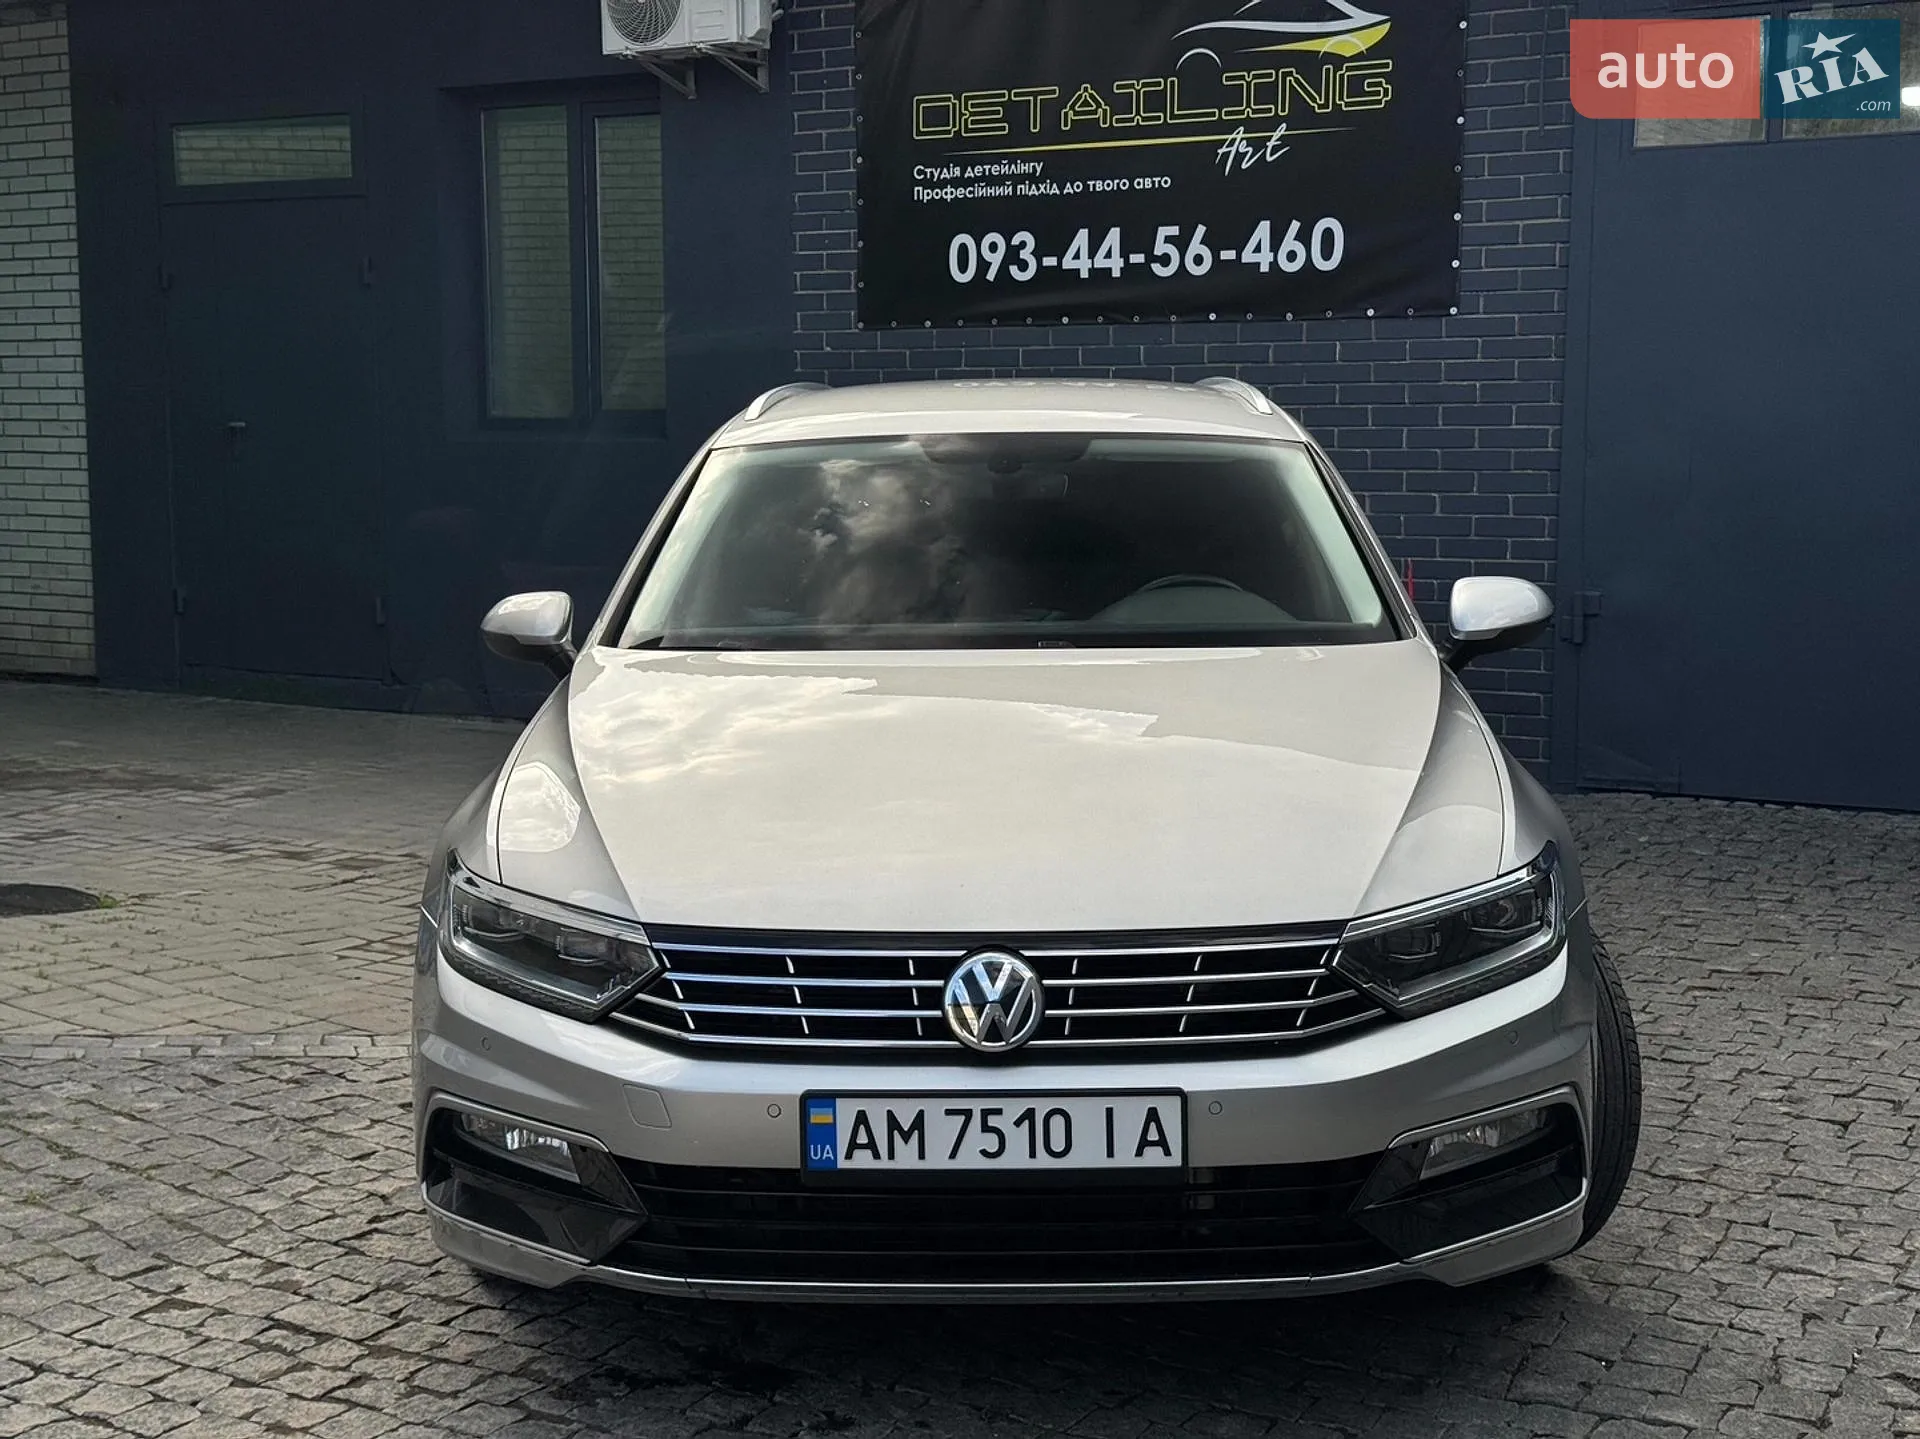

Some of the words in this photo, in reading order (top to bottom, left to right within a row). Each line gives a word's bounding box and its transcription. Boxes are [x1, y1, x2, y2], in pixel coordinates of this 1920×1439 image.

[913, 60, 1392, 139] DETAILING
[914, 163, 960, 181] Студія
[965, 160, 1043, 178] детейлінгу
[1215, 122, 1290, 177] Art
[914, 181, 1013, 203] Професійний
[1017, 179, 1060, 197] підхід
[1063, 180, 1083, 195] до
[1087, 178, 1129, 192] твого
[1133, 176, 1171, 190] авто
[949, 217, 1345, 283] 093-44-56-460
[810, 1144, 834, 1161] UA
[844, 1108, 926, 1160] AM
[944, 1107, 1073, 1159] 7510
[1105, 1106, 1172, 1158] IA
